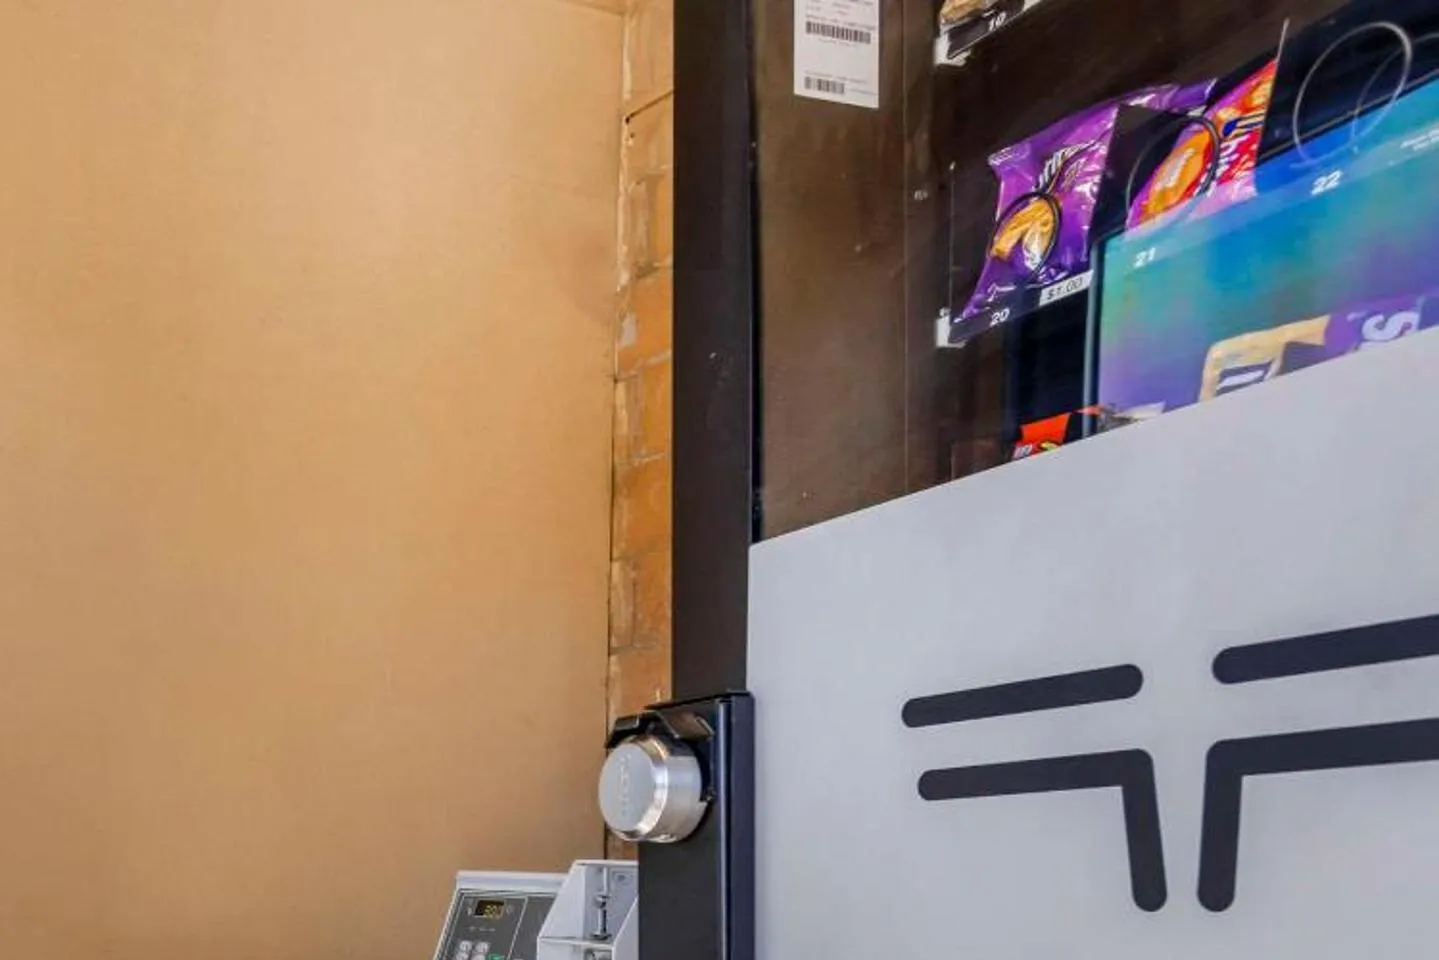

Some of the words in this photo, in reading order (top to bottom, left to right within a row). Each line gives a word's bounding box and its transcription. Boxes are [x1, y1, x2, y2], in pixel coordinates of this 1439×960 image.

[1310, 170, 1342, 196] 22
[1133, 247, 1157, 269] 21
[990, 308, 1011, 326] 20
